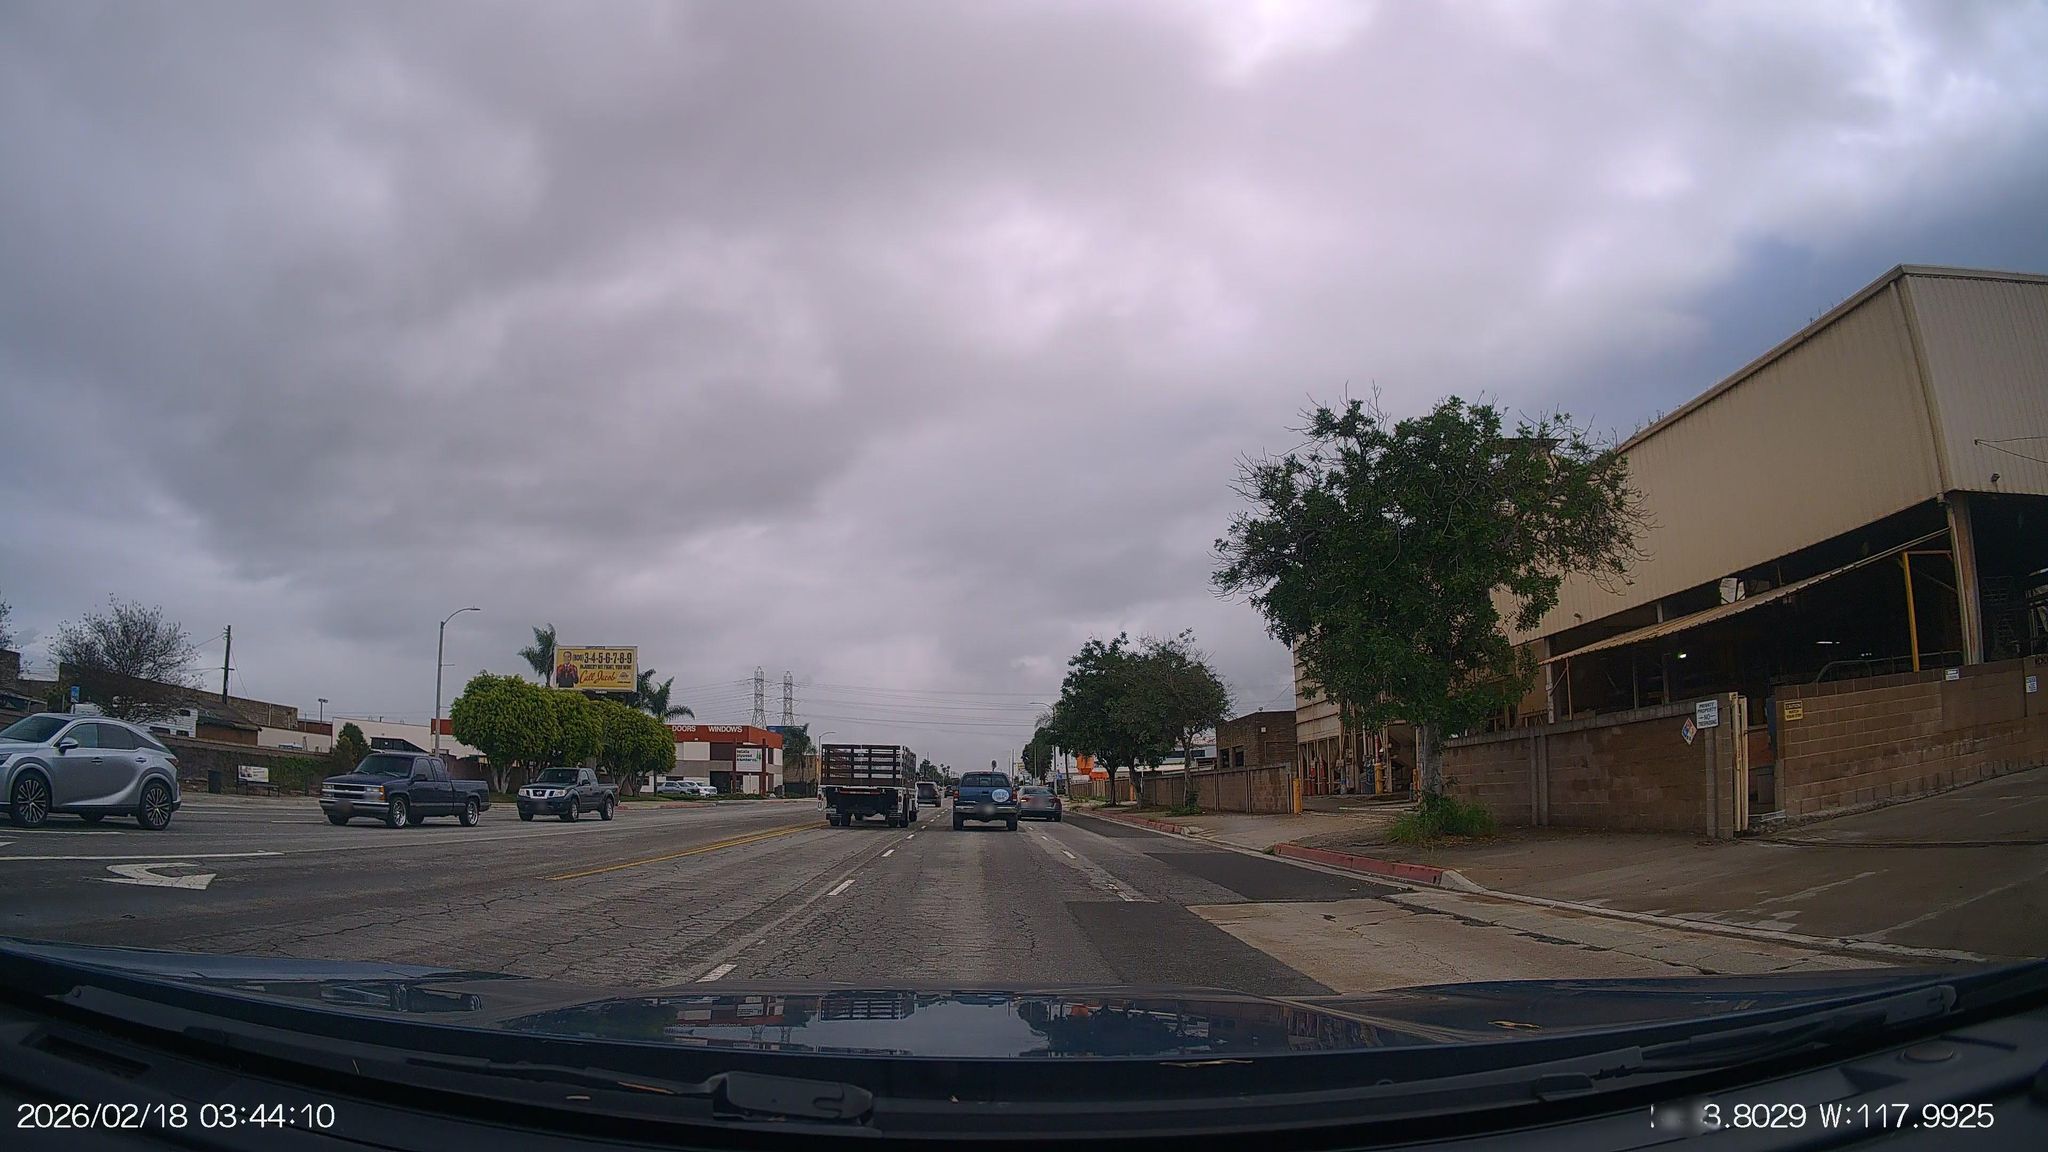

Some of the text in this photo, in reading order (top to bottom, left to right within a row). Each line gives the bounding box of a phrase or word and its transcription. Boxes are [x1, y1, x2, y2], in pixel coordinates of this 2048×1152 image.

[584, 652, 632, 664] 3-4-5-6-7-8-9
[580, 670, 595, 684] Call
[594, 670, 616, 683] Jacob
[708, 725, 743, 733] WINDOWS
